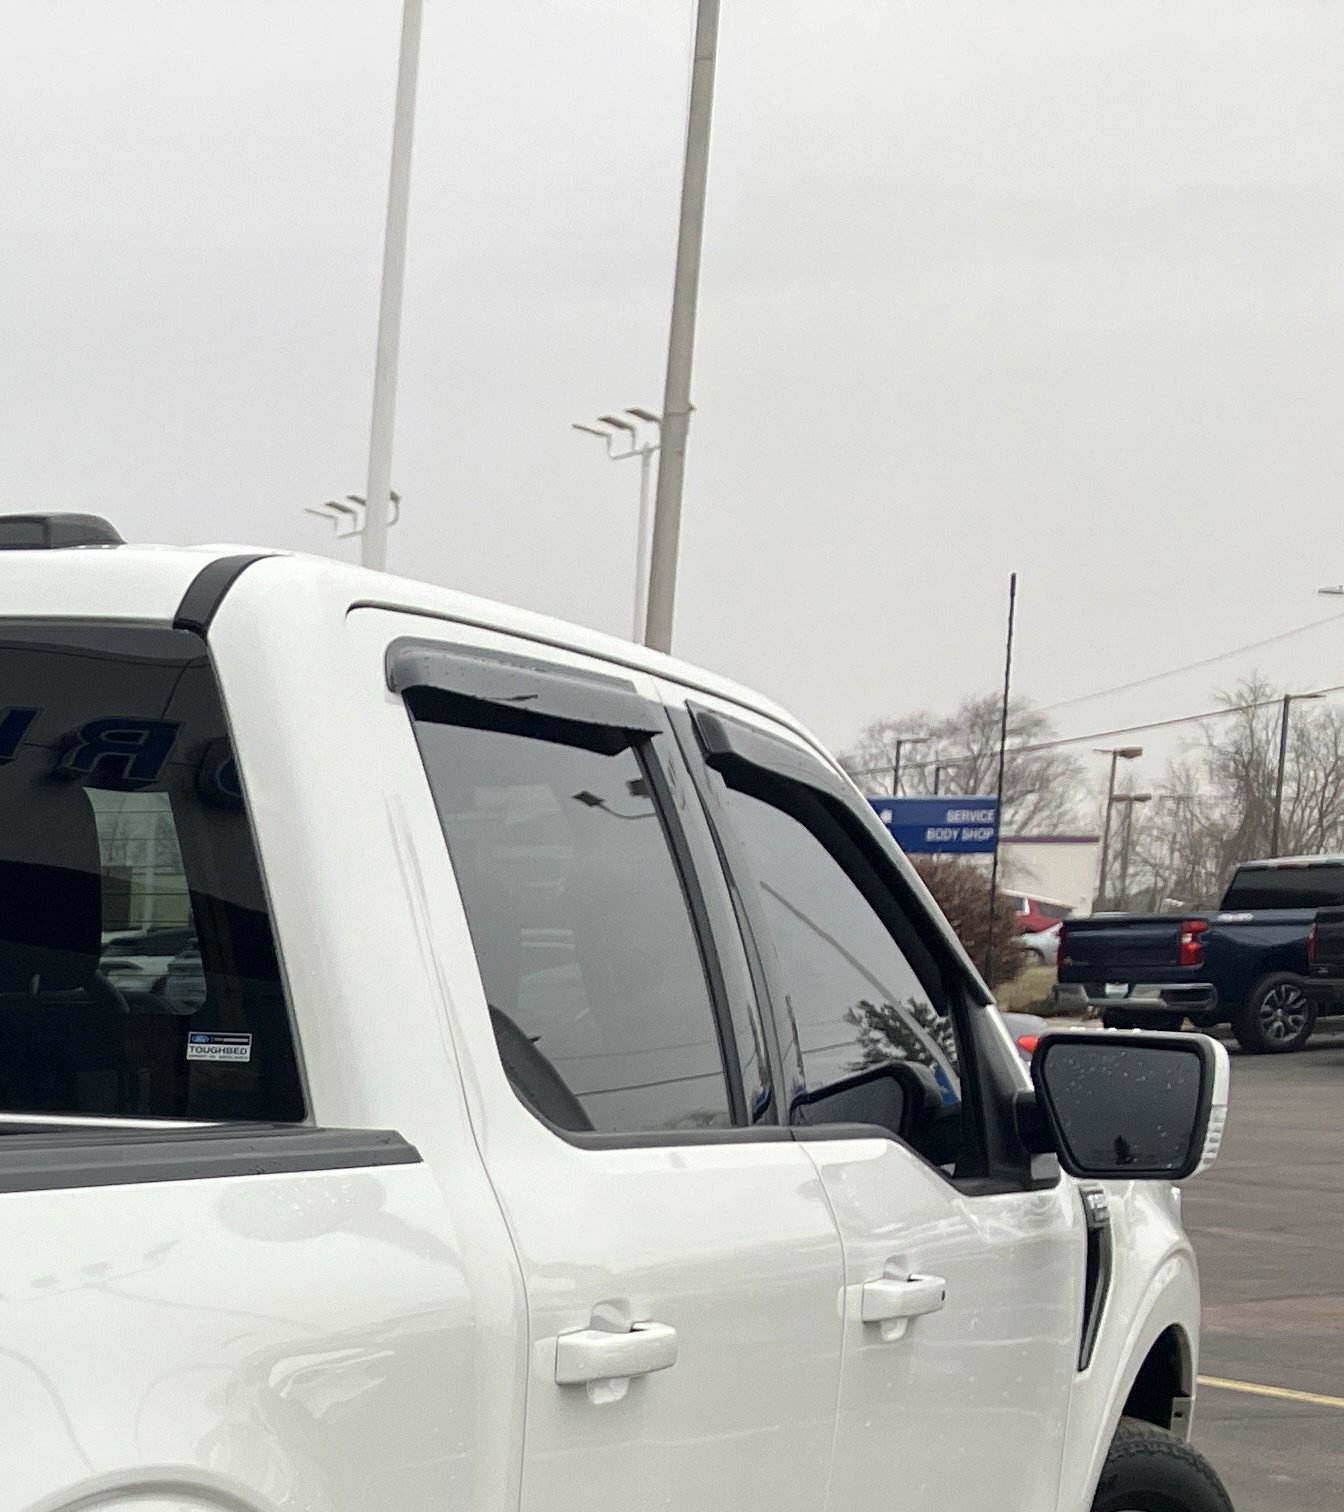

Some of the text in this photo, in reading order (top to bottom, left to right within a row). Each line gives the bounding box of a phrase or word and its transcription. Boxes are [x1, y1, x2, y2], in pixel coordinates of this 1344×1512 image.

[946, 809, 995, 823] SERVICE
[926, 827, 994, 842] BODY SHOP
[189, 1045, 248, 1055] TOUGHBED
